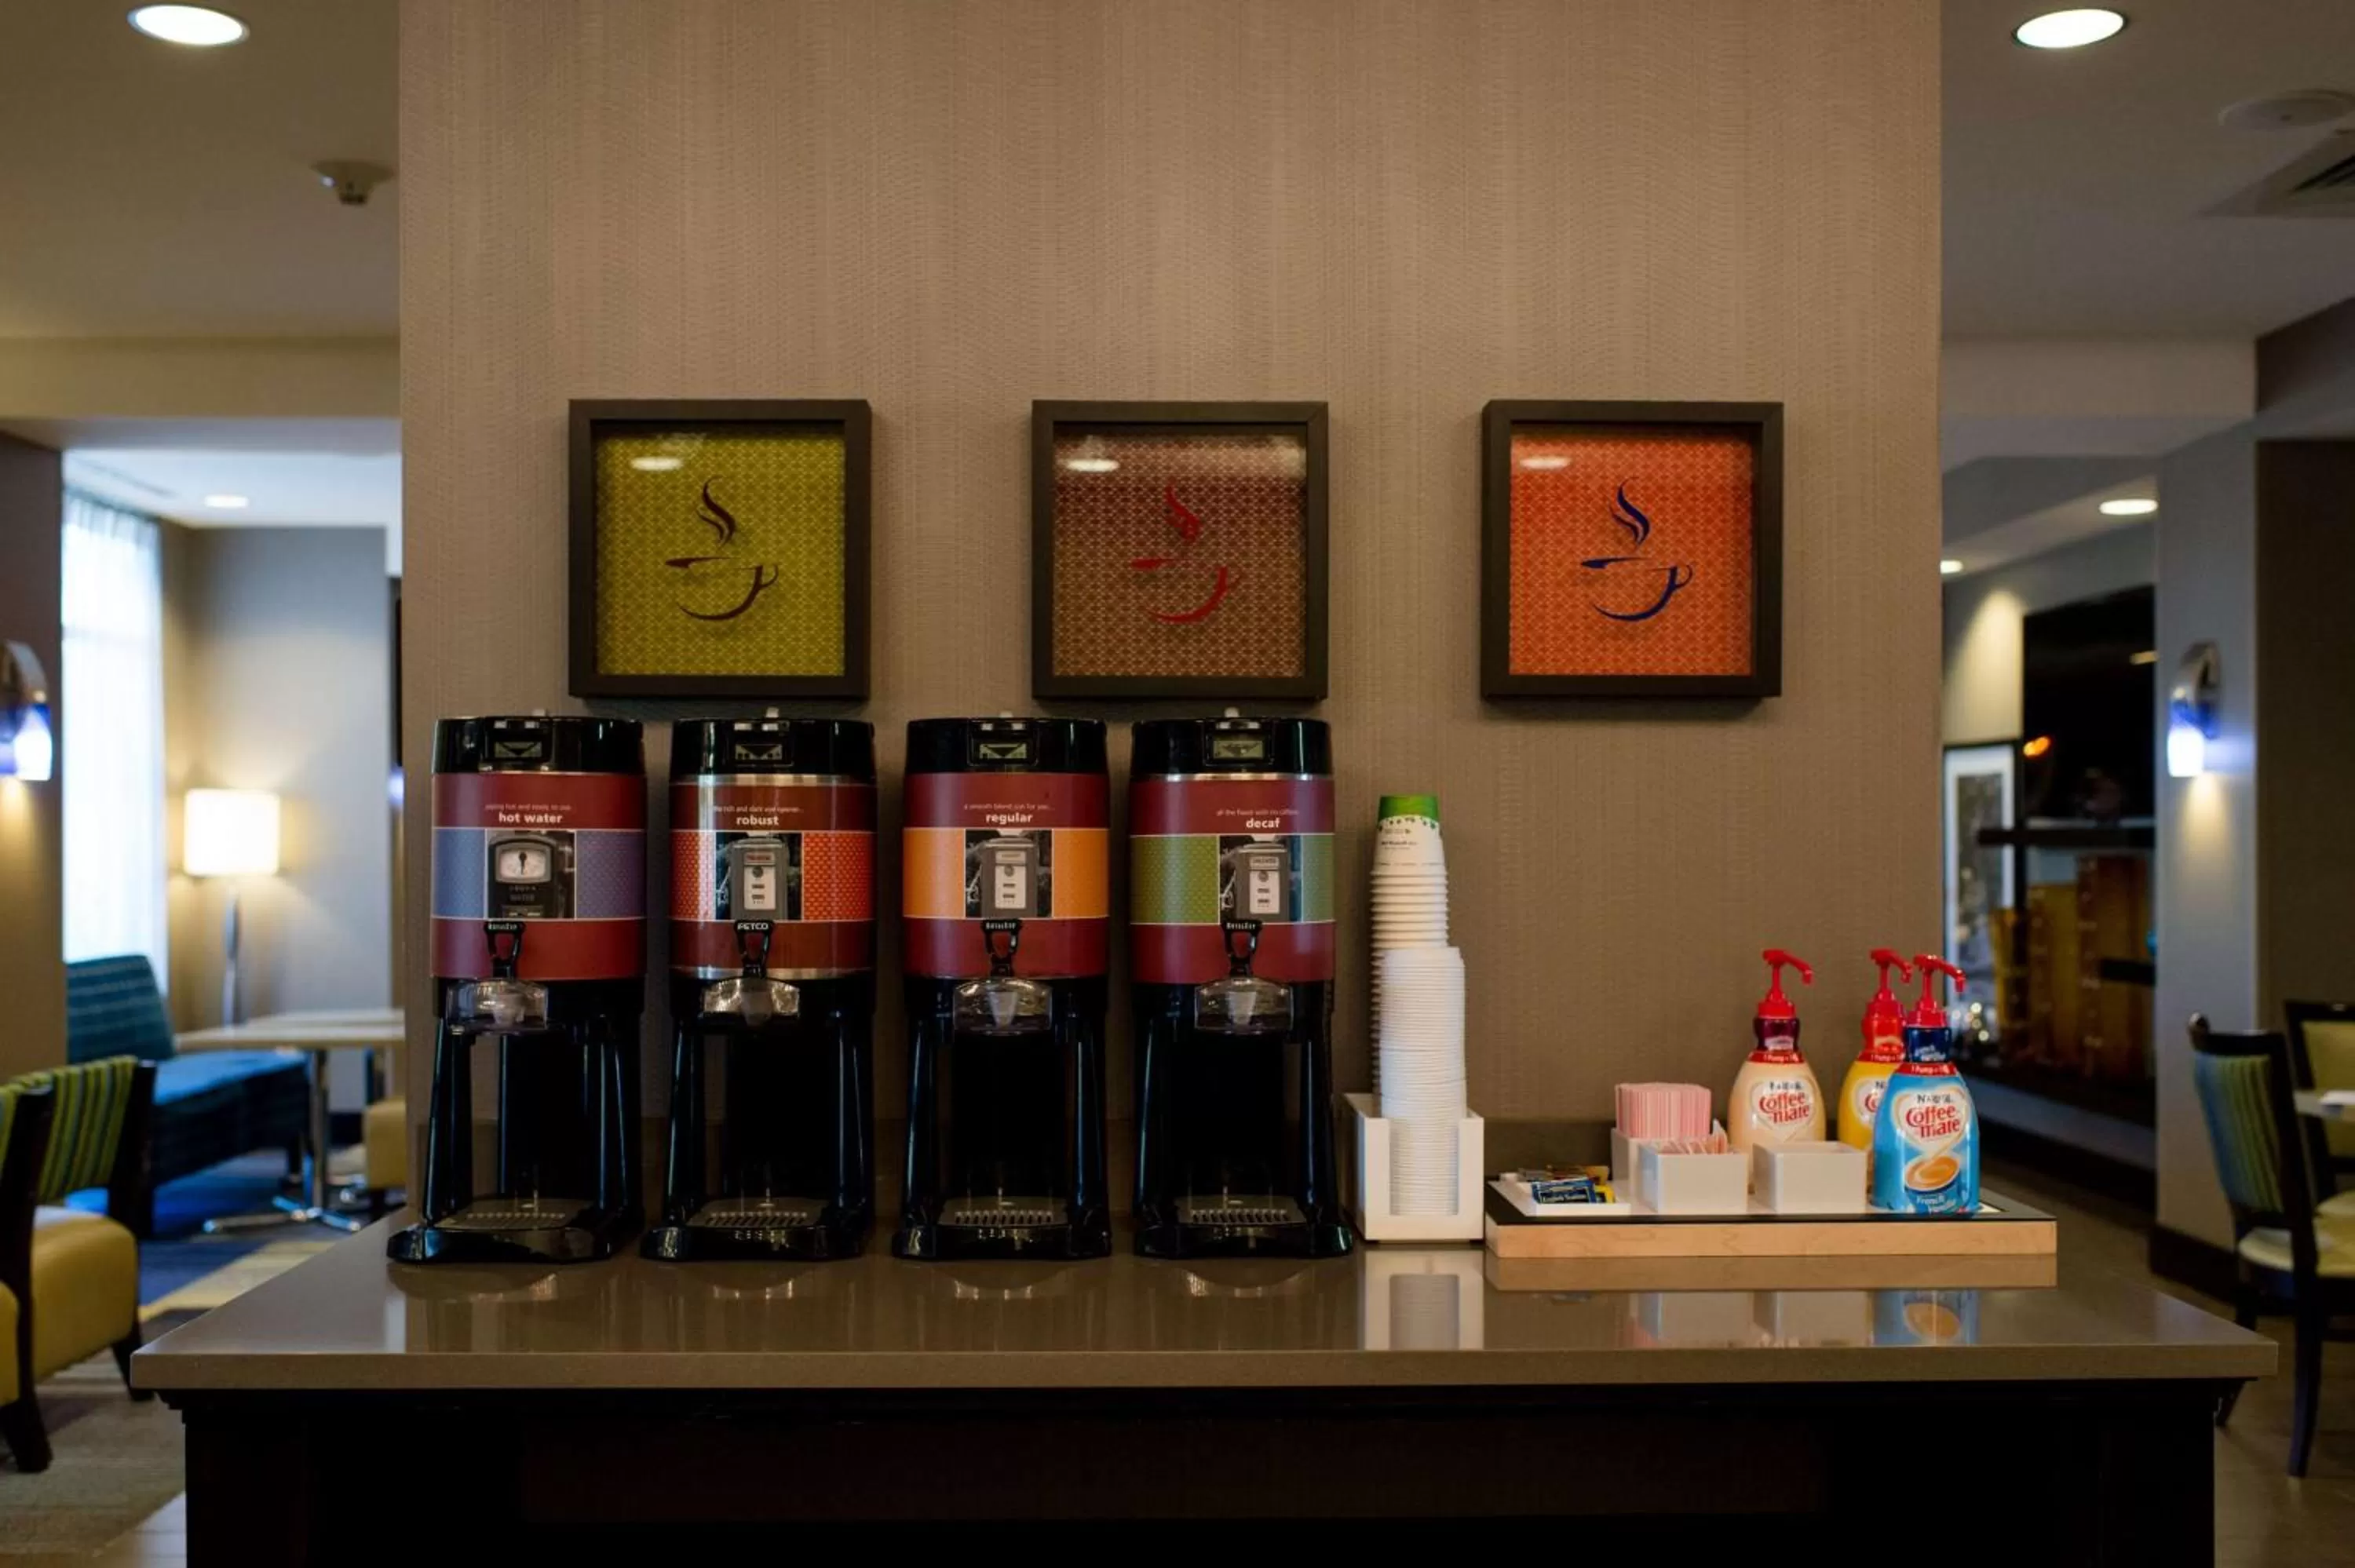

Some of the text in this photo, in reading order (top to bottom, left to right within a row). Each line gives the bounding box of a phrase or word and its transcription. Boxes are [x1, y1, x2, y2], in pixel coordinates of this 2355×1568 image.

[498, 811, 563, 823] hot water
[736, 815, 780, 826] robust
[985, 811, 1033, 825] regular
[1246, 818, 1280, 828] decaf
[1759, 1092, 1806, 1114] Coffee
[1773, 1104, 1809, 1124] mate
[1906, 1105, 1956, 1129] Coffee
[1921, 1118, 1961, 1138] mate
